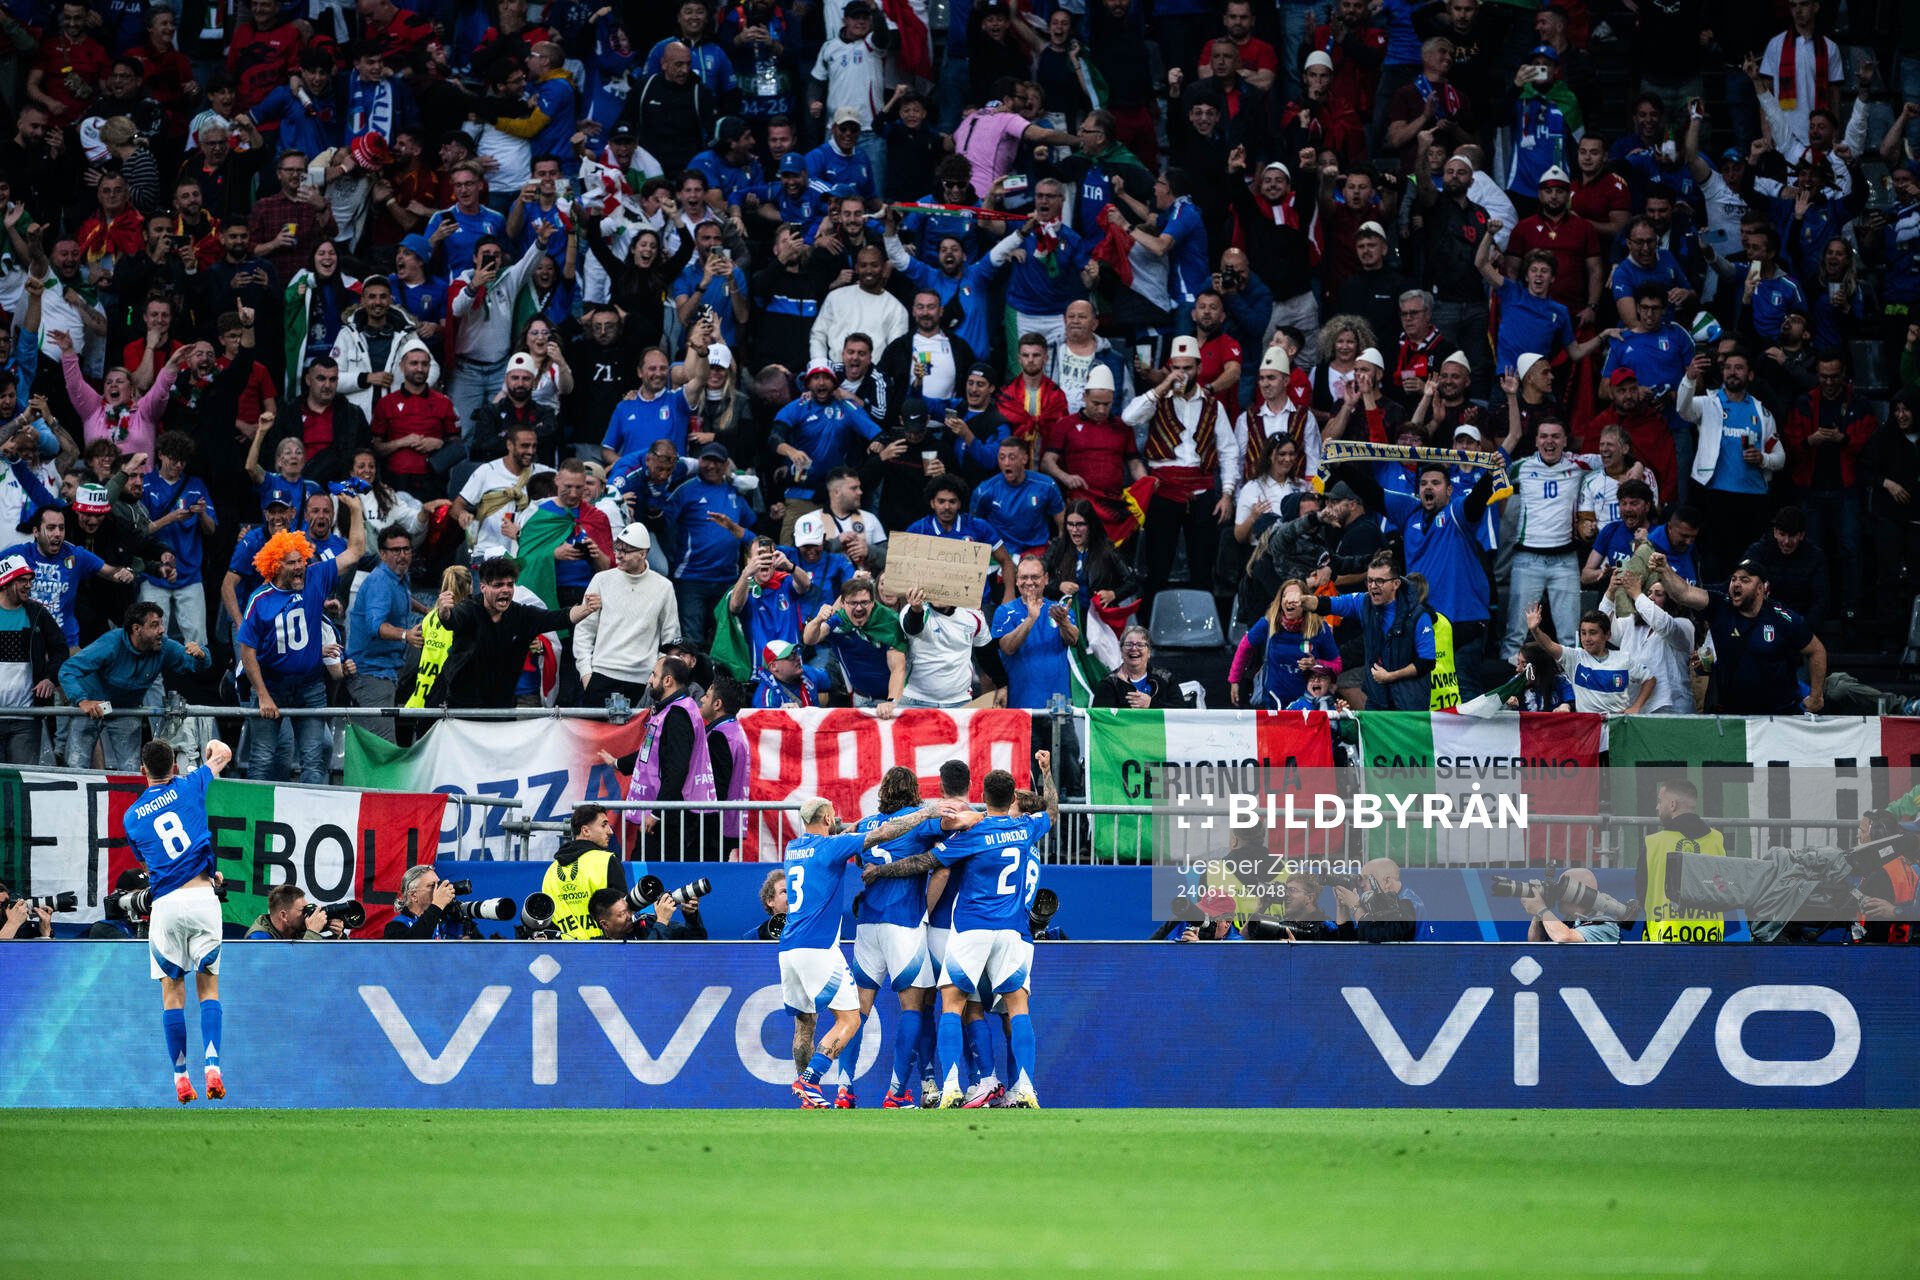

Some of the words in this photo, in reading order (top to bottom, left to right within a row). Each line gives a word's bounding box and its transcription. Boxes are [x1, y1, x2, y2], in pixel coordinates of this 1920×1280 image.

[1083, 183, 1104, 201] ITA
[1543, 480, 1558, 499] 10
[275, 607, 309, 654] 10
[1121, 755, 1303, 800] CERIGNOLA
[1372, 754, 1428, 780] SAN
[1436, 755, 1580, 781] SEVERINO
[134, 788, 179, 820] JORGINHO
[153, 811, 192, 860] 8
[985, 834, 996, 846] DI
[997, 829, 1028, 844] LORENZO
[787, 865, 805, 914] 3
[996, 847, 1021, 895] 2
[358, 953, 882, 1086] vivo
[1341, 955, 1862, 1087] vivo
